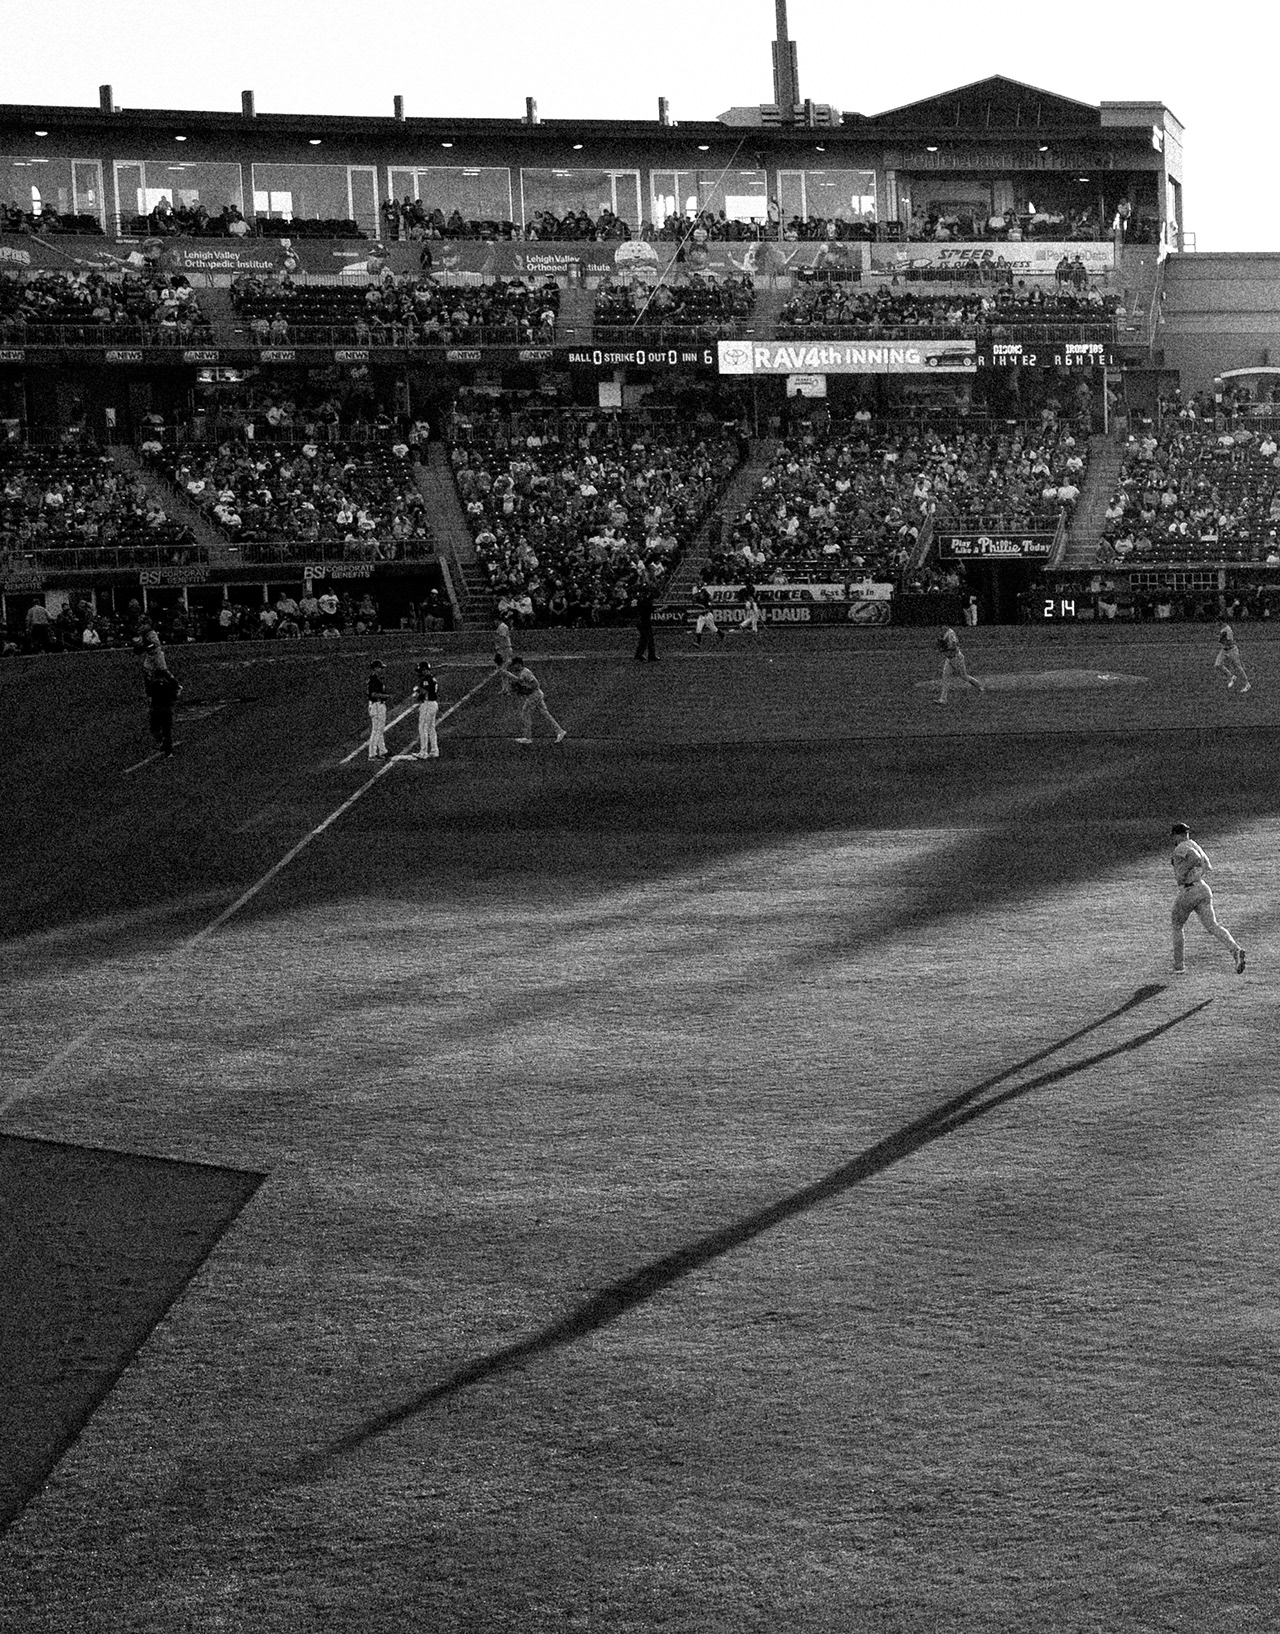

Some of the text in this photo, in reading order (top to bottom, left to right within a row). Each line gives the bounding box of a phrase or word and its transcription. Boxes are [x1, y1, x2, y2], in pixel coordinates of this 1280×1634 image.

[184, 250, 240, 260] Lehigh Valley
[526, 255, 555, 264] Lehigh
[938, 248, 993, 260] SPEED
[569, 350, 713, 364] BALL 0 STRIKE 0 OUT 0 INN 6
[755, 348, 920, 368] RAV4th INNING
[978, 355, 985, 366] R
[999, 355, 1007, 365] H
[1055, 355, 1062, 365] R
[1076, 355, 1083, 365] H
[1099, 355, 1105, 365] E
[978, 537, 1022, 556] Phillie
[1022, 540, 1051, 552] Today
[139, 571, 162, 585] BSI
[304, 564, 375, 579] BSI CORPORATE
